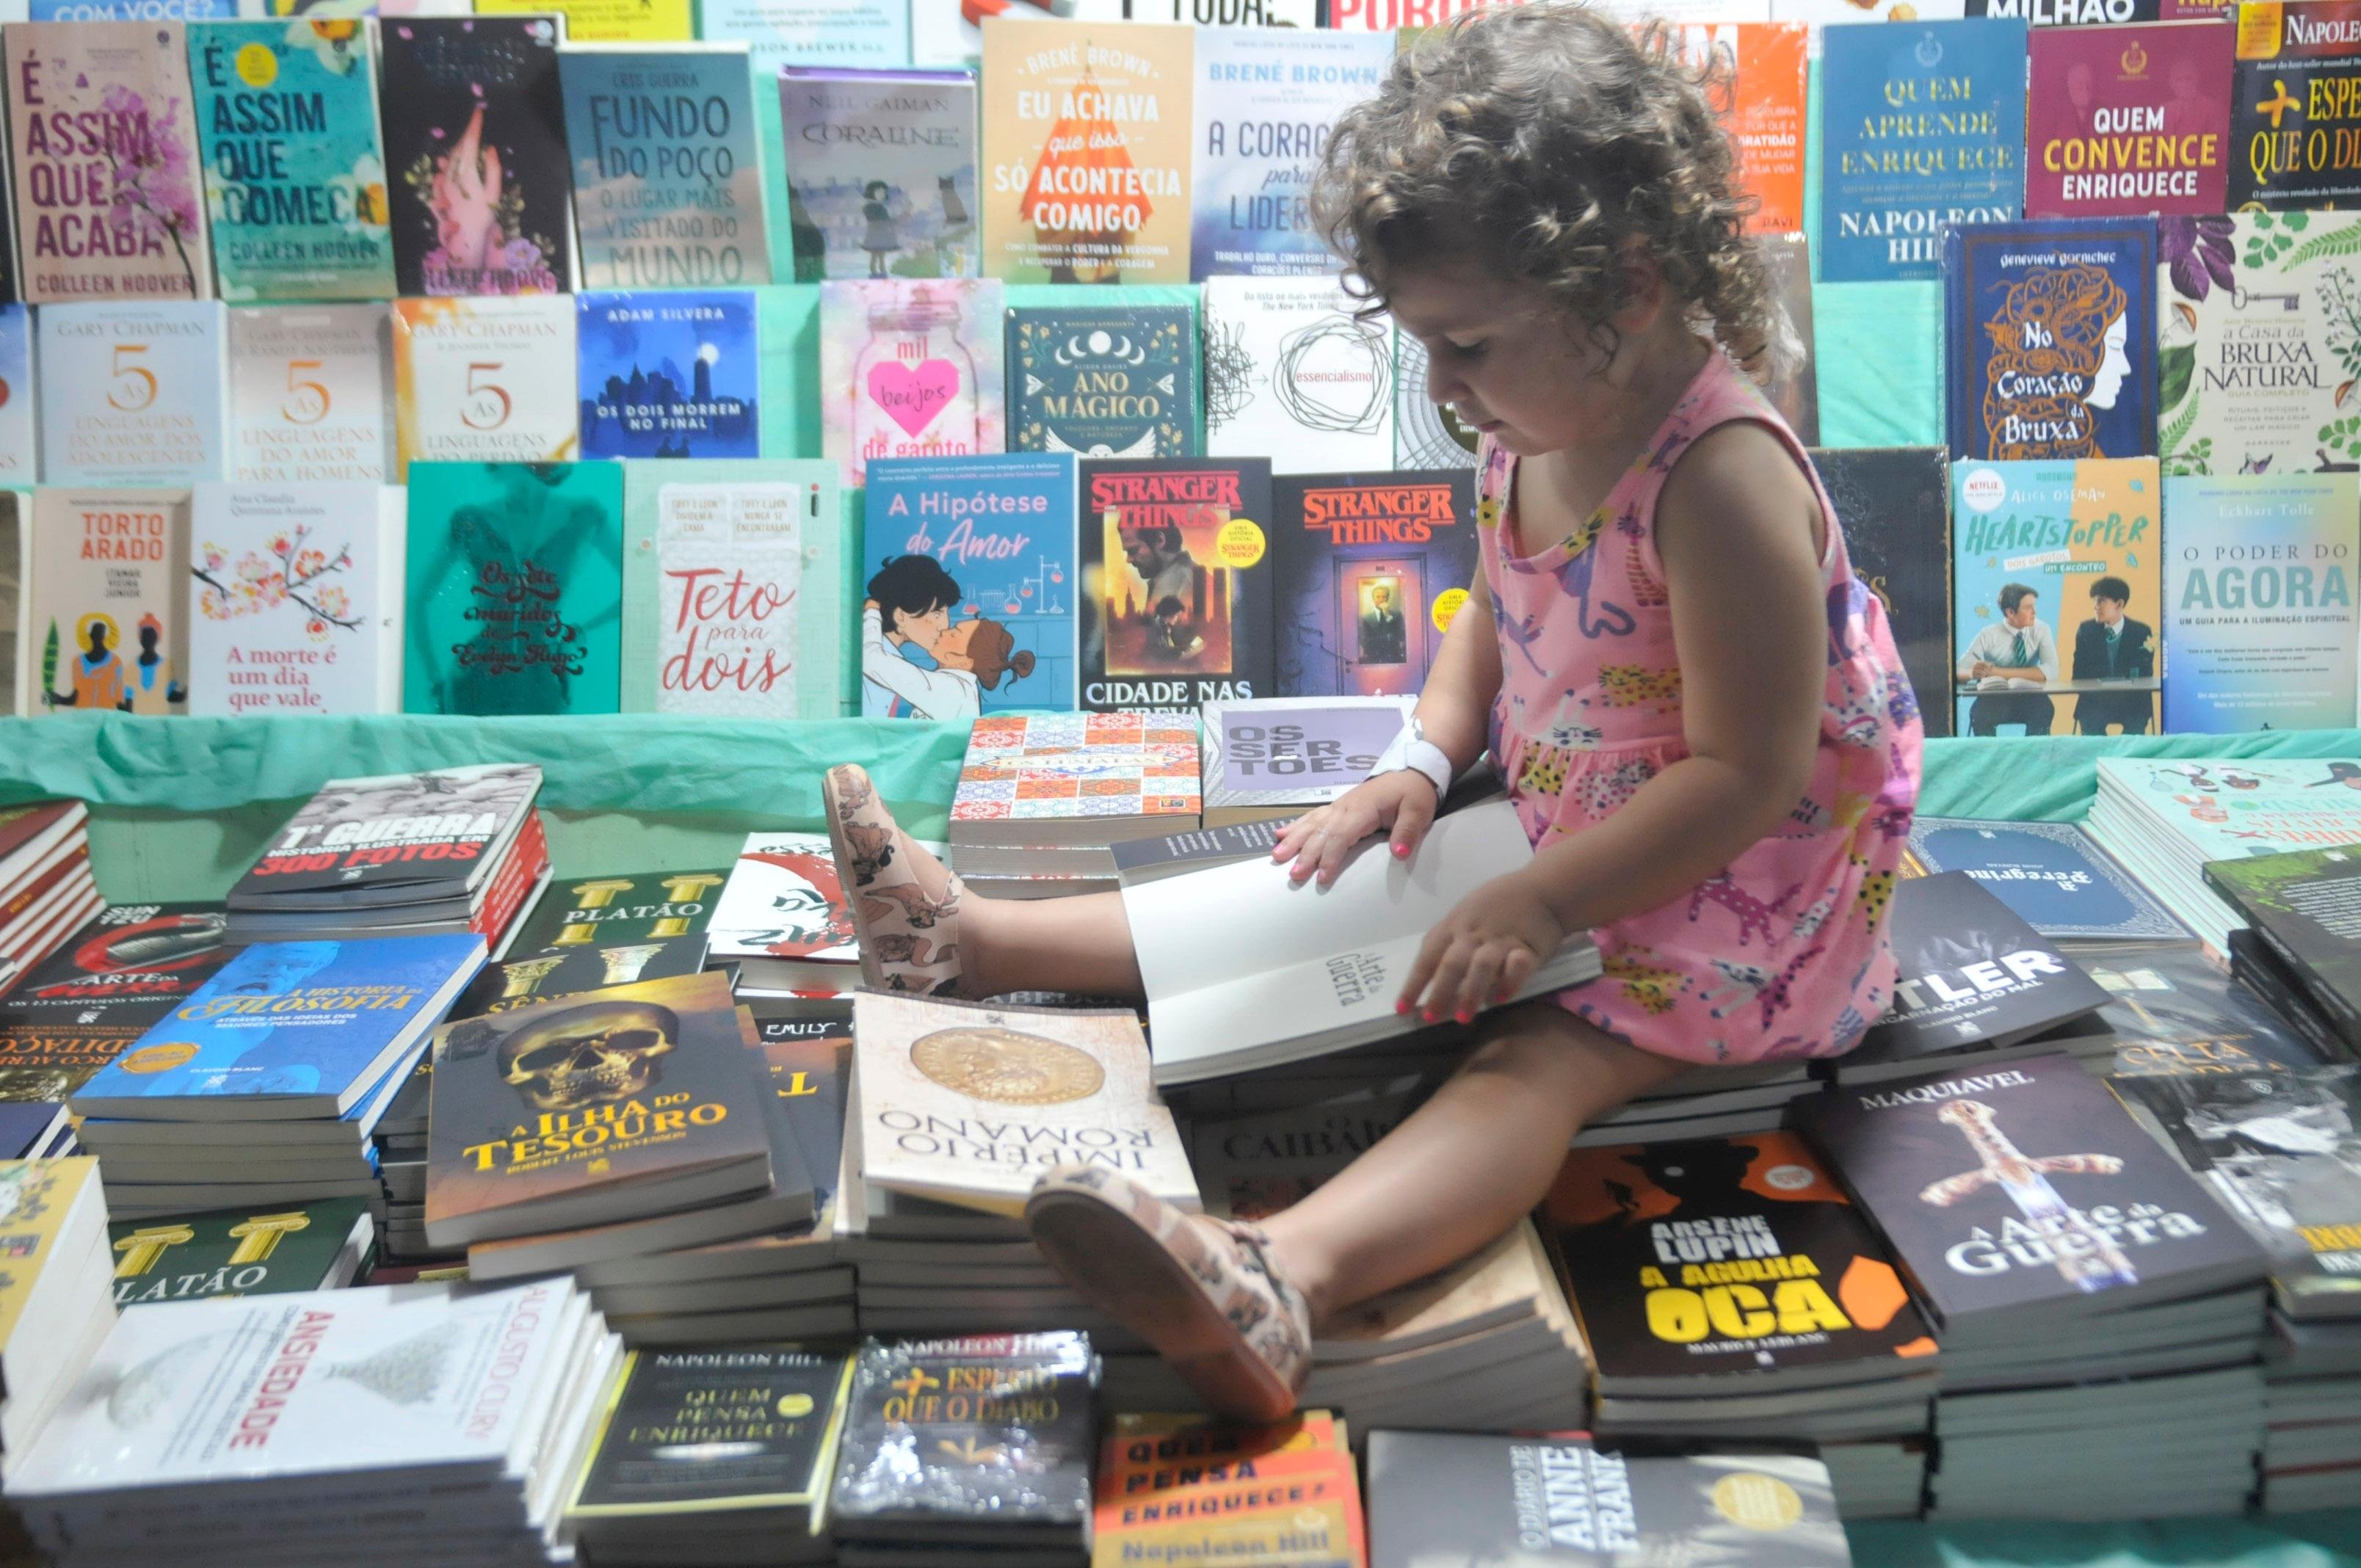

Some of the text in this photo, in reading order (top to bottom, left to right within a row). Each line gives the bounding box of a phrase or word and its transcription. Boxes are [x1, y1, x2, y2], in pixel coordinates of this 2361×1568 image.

[205, 37, 228, 87] É
[1028, 43, 1151, 79] BRENÉ BROWN
[1210, 59, 1379, 83] BRENÉ BROWN
[21, 50, 43, 104] É
[1885, 76, 1972, 107] QUEM
[213, 92, 327, 134] ASSIM
[809, 94, 858, 110] NEIL
[1018, 92, 1160, 122] EU ACHAVA
[26, 110, 156, 156] ASSIM
[1860, 112, 1997, 139] APRENDE
[2094, 106, 2164, 133] QUEM
[590, 95, 730, 178] FUNDO
[802, 123, 961, 148] CORALINE
[1049, 135, 1085, 156] que
[215, 140, 289, 181] QUE
[1842, 145, 2015, 176] ENRIQUECE
[2044, 134, 2218, 172] CONVENCE
[612, 148, 733, 188] DO POÇO
[994, 159, 1182, 197] SÓ ACONTECIA
[29, 163, 108, 207] QUE
[601, 188, 736, 208] O LUGAR MAIS
[2062, 171, 2198, 200] ENRIQUECE
[603, 218, 739, 239] VISITADO DO
[1033, 203, 1141, 233] COMIGO
[35, 214, 164, 258] ACABA
[608, 247, 744, 286] MUNDO
[37, 273, 195, 294] COLLEEN HOOVER
[608, 308, 725, 323] ADAM SILVERA
[466, 323, 558, 338] CHAPMAN
[2025, 320, 2053, 349] No
[2238, 324, 2281, 340] Casa
[2287, 327, 2304, 339] da
[896, 338, 929, 360] mil
[2220, 341, 2314, 365] BRUXA
[107, 345, 157, 412] 5
[1073, 371, 1130, 393] ANO
[1296, 369, 1374, 385] essencialismo
[1997, 370, 2084, 399] Coração
[2204, 363, 2333, 391] NATURAL
[283, 360, 330, 424] 5
[460, 363, 512, 430] 5
[881, 382, 946, 413] beijos
[1042, 391, 1160, 420] MÁGICO
[474, 401, 498, 418] As
[596, 404, 741, 418] OS DOIS MORREM
[629, 418, 708, 431] NO FINAL
[2004, 416, 2080, 445] Bruxa
[427, 433, 548, 449] LINGUAGENS
[863, 438, 968, 462] de garoto
[1092, 471, 1244, 513] STRANGER
[1969, 482, 1998, 491] NETFLIX
[2012, 487, 2107, 504] ALICE OSEMAN
[888, 489, 1050, 523] A Hipótese
[1117, 503, 1219, 530] THINGS
[1304, 487, 1456, 526] STRANGER
[2219, 503, 2315, 518] Eckhart Tolle
[81, 512, 164, 537] TORTO
[1330, 518, 1432, 545] THINGS
[1965, 511, 2150, 556] HEARTSTOPPER
[80, 538, 164, 562] ARADO
[904, 518, 1031, 566] do Amor
[2183, 543, 2349, 561] O PODER DO
[665, 567, 796, 634] Teto
[2180, 565, 2351, 610] AGORA
[2179, 618, 2192, 626] UM
[2195, 617, 2215, 625] GUIA
[706, 623, 769, 651] para
[228, 645, 337, 664] A morte é
[663, 626, 792, 694] dois
[228, 666, 310, 686] um dia
[228, 688, 322, 708] que vale
[1087, 680, 1253, 706] CIDADE NAS
[1227, 725, 1305, 741] OS
[1228, 742, 1343, 757] SER
[322, 812, 497, 846] GUERRA
[457, 834, 491, 843] EM
[253, 841, 484, 876] 300 FOTOS
[562, 900, 704, 923] PLATÃO
[84, 973, 162, 985] ARTE
[1325, 952, 1366, 1008] Guerra
[1356, 954, 1389, 986] Arte
[178, 993, 416, 1021] FILOSOFIA
[764, 1022, 838, 1036] EMILY
[1860, 1070, 2036, 1111] MAQUIAVEL
[511, 1091, 691, 1137] A ILHA DO
[463, 1103, 728, 1172] TESOURO
[880, 1110, 1153, 1149] ROMANO
[897, 1133, 1146, 1169] IMPÉRIO
[1970, 1226, 1992, 1241] A
[1998, 1204, 2125, 1246] Arte
[1653, 1231, 1781, 1263] LUPIN
[1945, 1211, 2208, 1276] Guerra
[1639, 1253, 1821, 1288] A AGULHA
[1644, 1278, 1852, 1343] OCA
[656, 1352, 772, 1368] NAPOLEON
[228, 1310, 336, 1450] ANSIEDADE
[883, 1394, 942, 1423] QUE
[946, 1397, 969, 1420] O
[1125, 1462, 1258, 1492] PENSA
[1539, 1445, 1596, 1550] ANNE
[1122, 1527, 1331, 1564] Napoleon Hill
